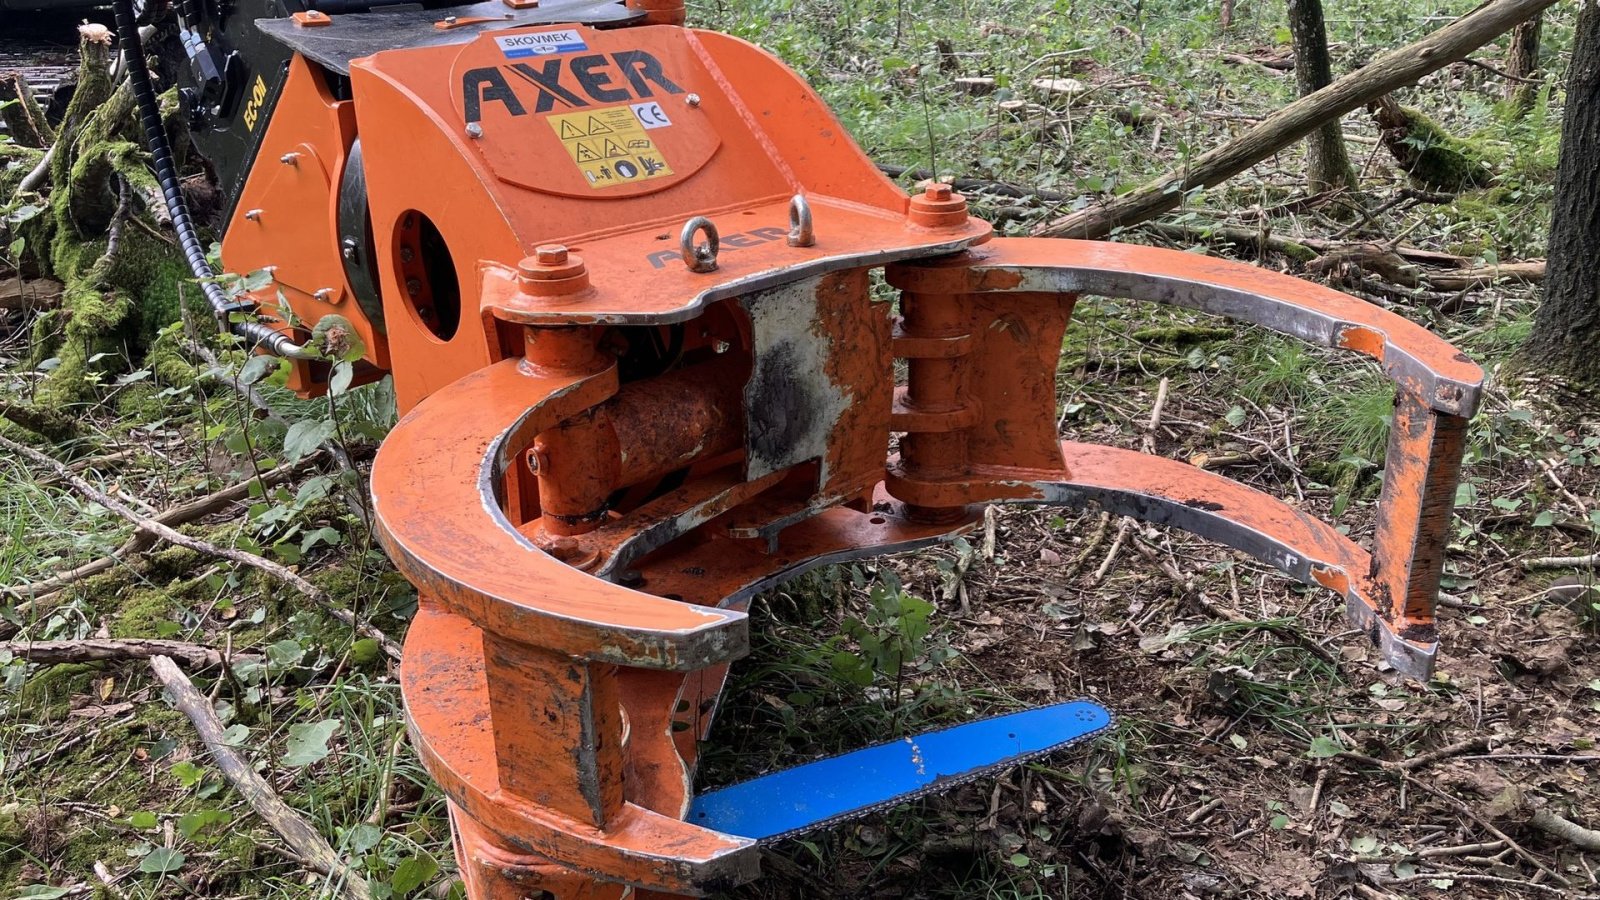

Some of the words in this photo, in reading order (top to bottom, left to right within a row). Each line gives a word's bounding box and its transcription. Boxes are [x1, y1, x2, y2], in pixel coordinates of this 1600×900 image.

[505, 33, 572, 47] SKOVMEK
[463, 49, 686, 123] AXER
[637, 104, 668, 125] CE
[646, 226, 789, 269] AER
